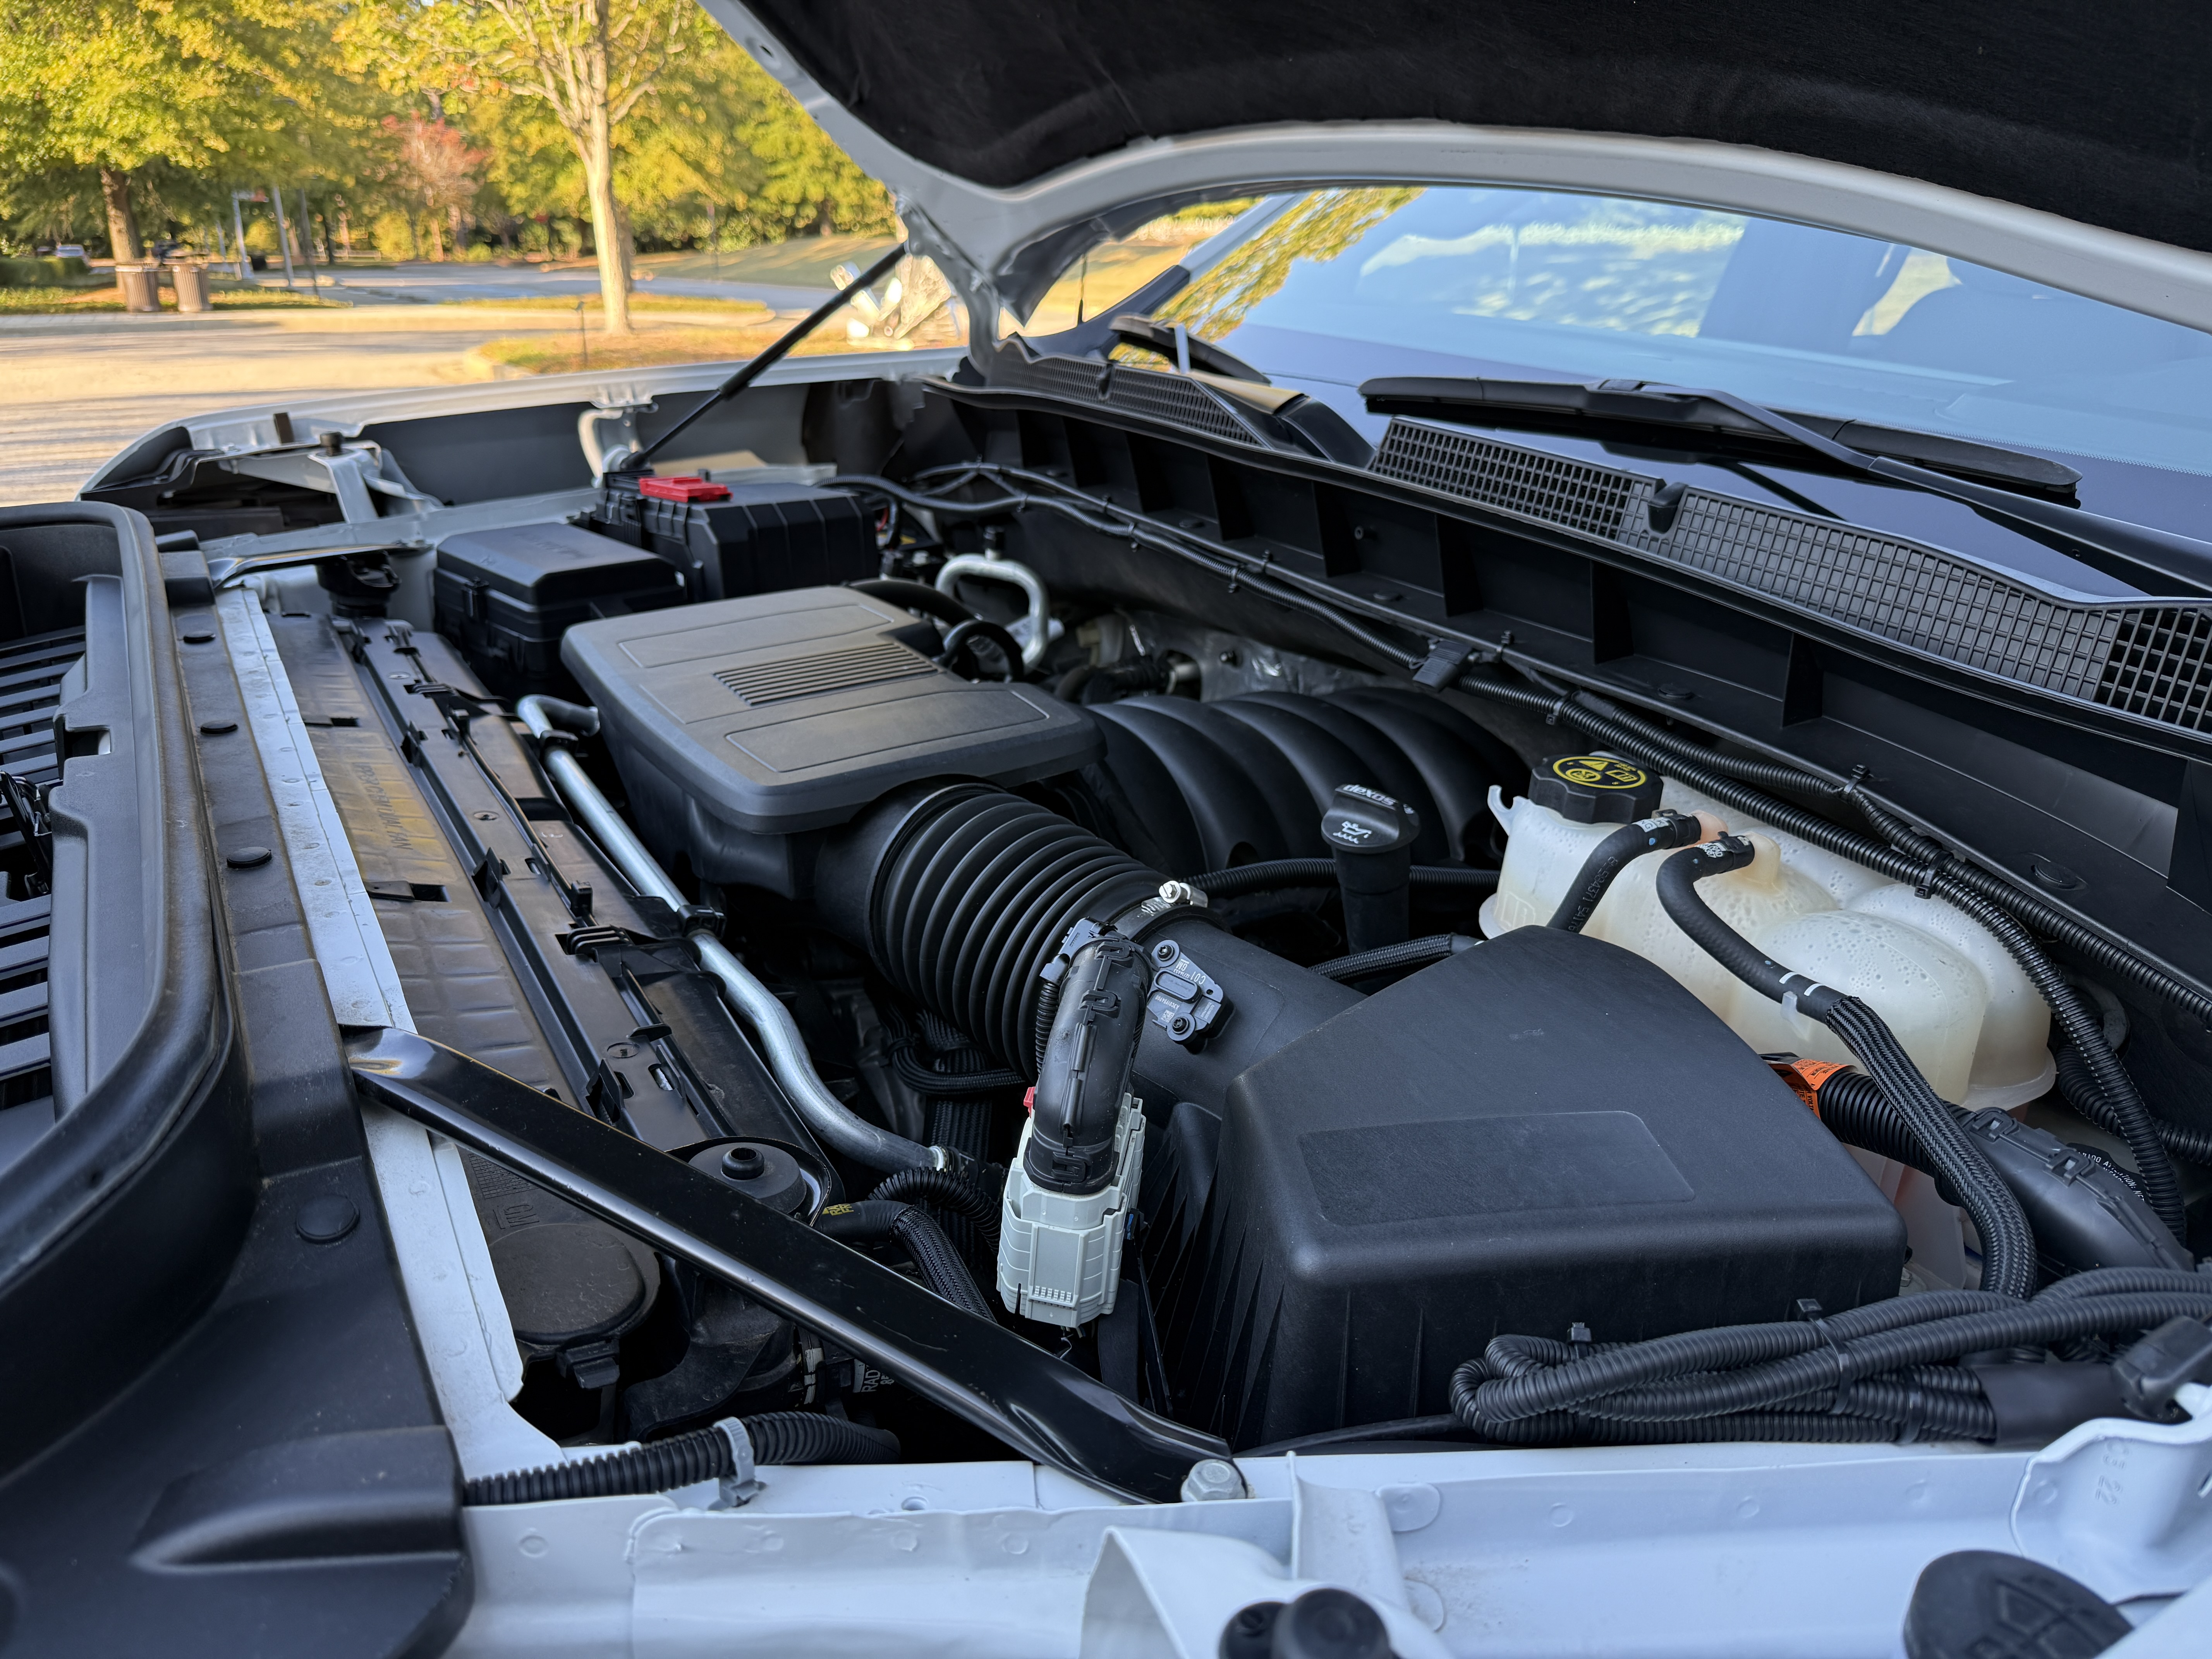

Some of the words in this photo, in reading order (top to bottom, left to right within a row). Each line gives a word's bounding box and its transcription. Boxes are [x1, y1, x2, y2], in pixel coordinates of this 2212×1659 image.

[1342, 784, 1397, 806] dexos
[387, 832, 413, 849] FAN
[1175, 960, 1188, 972] GM
[1190, 970, 1206, 985] C01
[503, 1204, 539, 1227] GM
[862, 1369, 881, 1392] RAD
